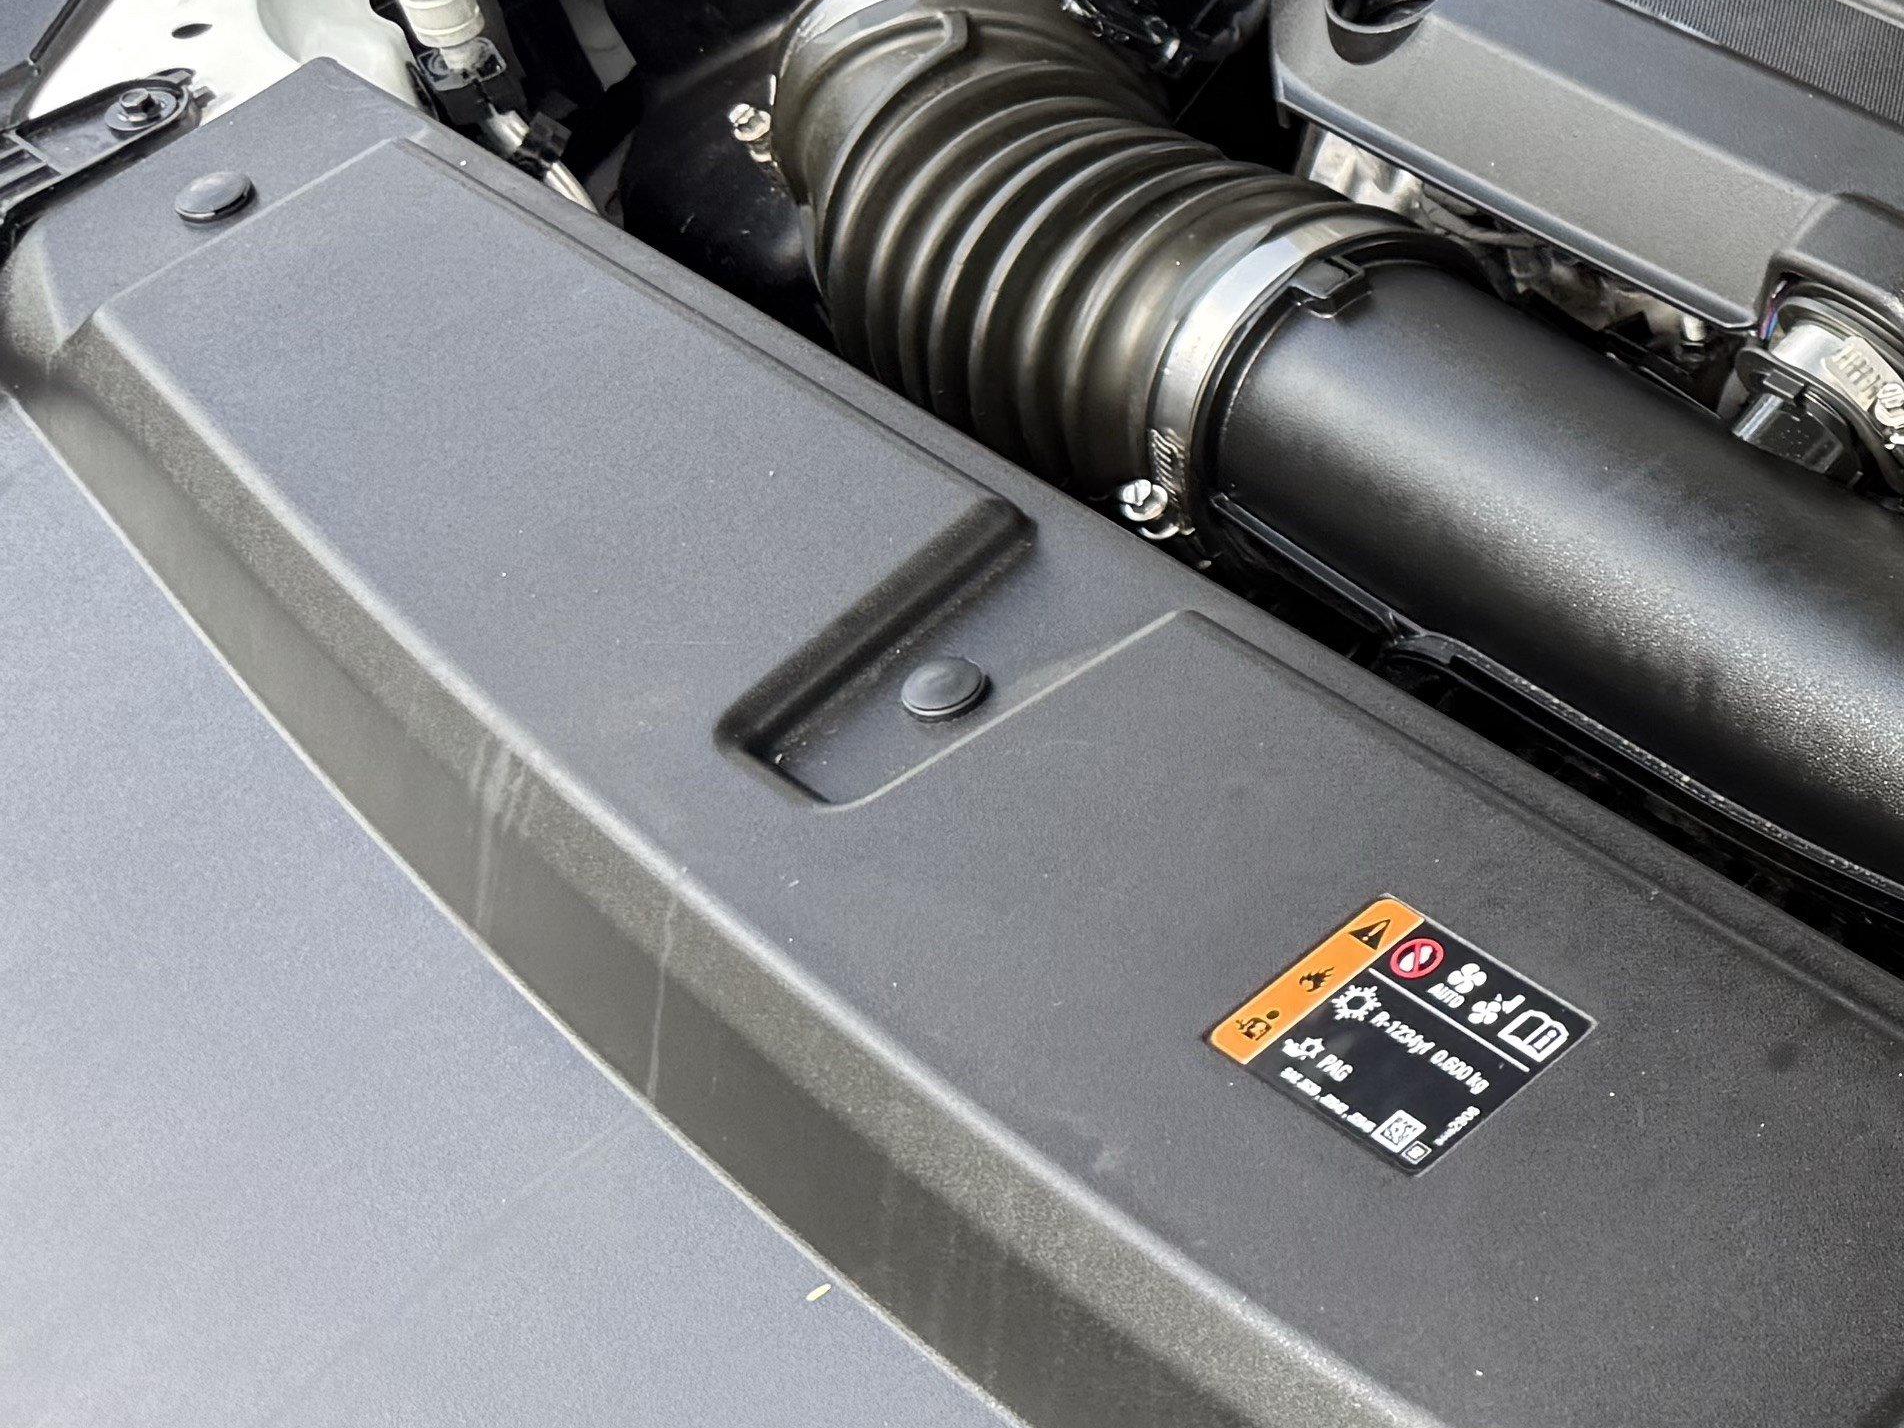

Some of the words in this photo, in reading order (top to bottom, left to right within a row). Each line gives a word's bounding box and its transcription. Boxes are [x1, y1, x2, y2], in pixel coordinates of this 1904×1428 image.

[1426, 982, 1465, 1009] AUTO
[1369, 1010, 1436, 1056] R-1234yf
[1429, 1049, 1474, 1081] 0.600
[1464, 1071, 1490, 1095] kg
[1315, 1053, 1354, 1083] PAG
